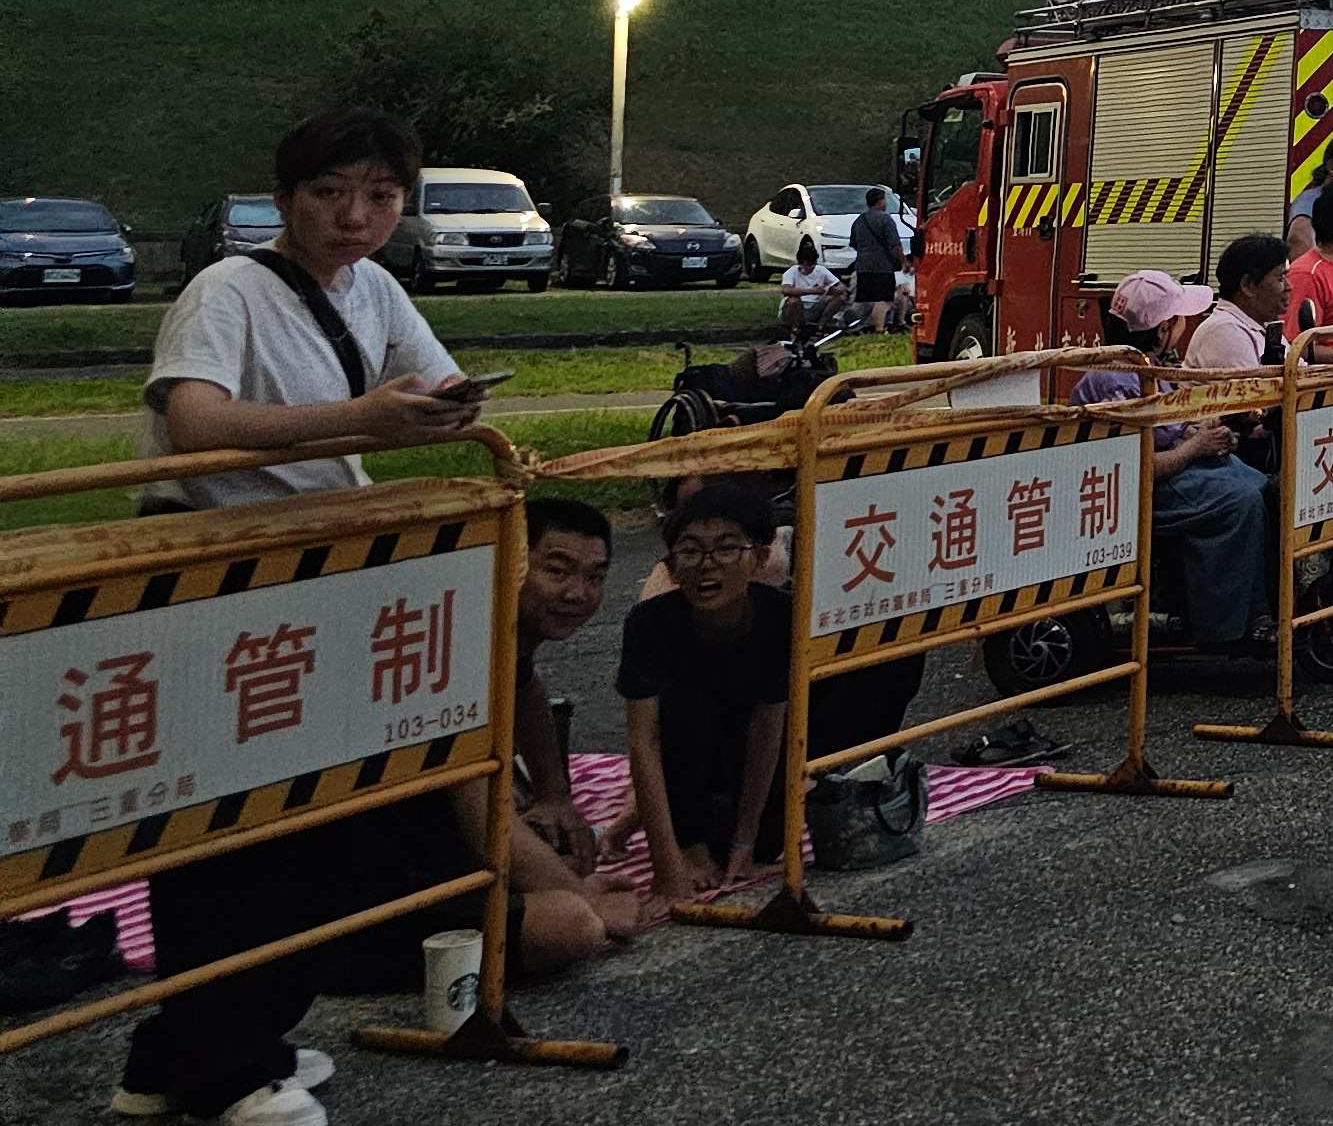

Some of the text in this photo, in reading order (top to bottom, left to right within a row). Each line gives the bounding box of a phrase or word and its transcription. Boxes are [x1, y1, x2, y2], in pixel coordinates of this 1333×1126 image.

[841, 463, 1120, 593] 交通管制
[1085, 541, 1132, 567] 103-039
[52, 589, 456, 785] 通管制
[384, 700, 479, 744] 103-034
